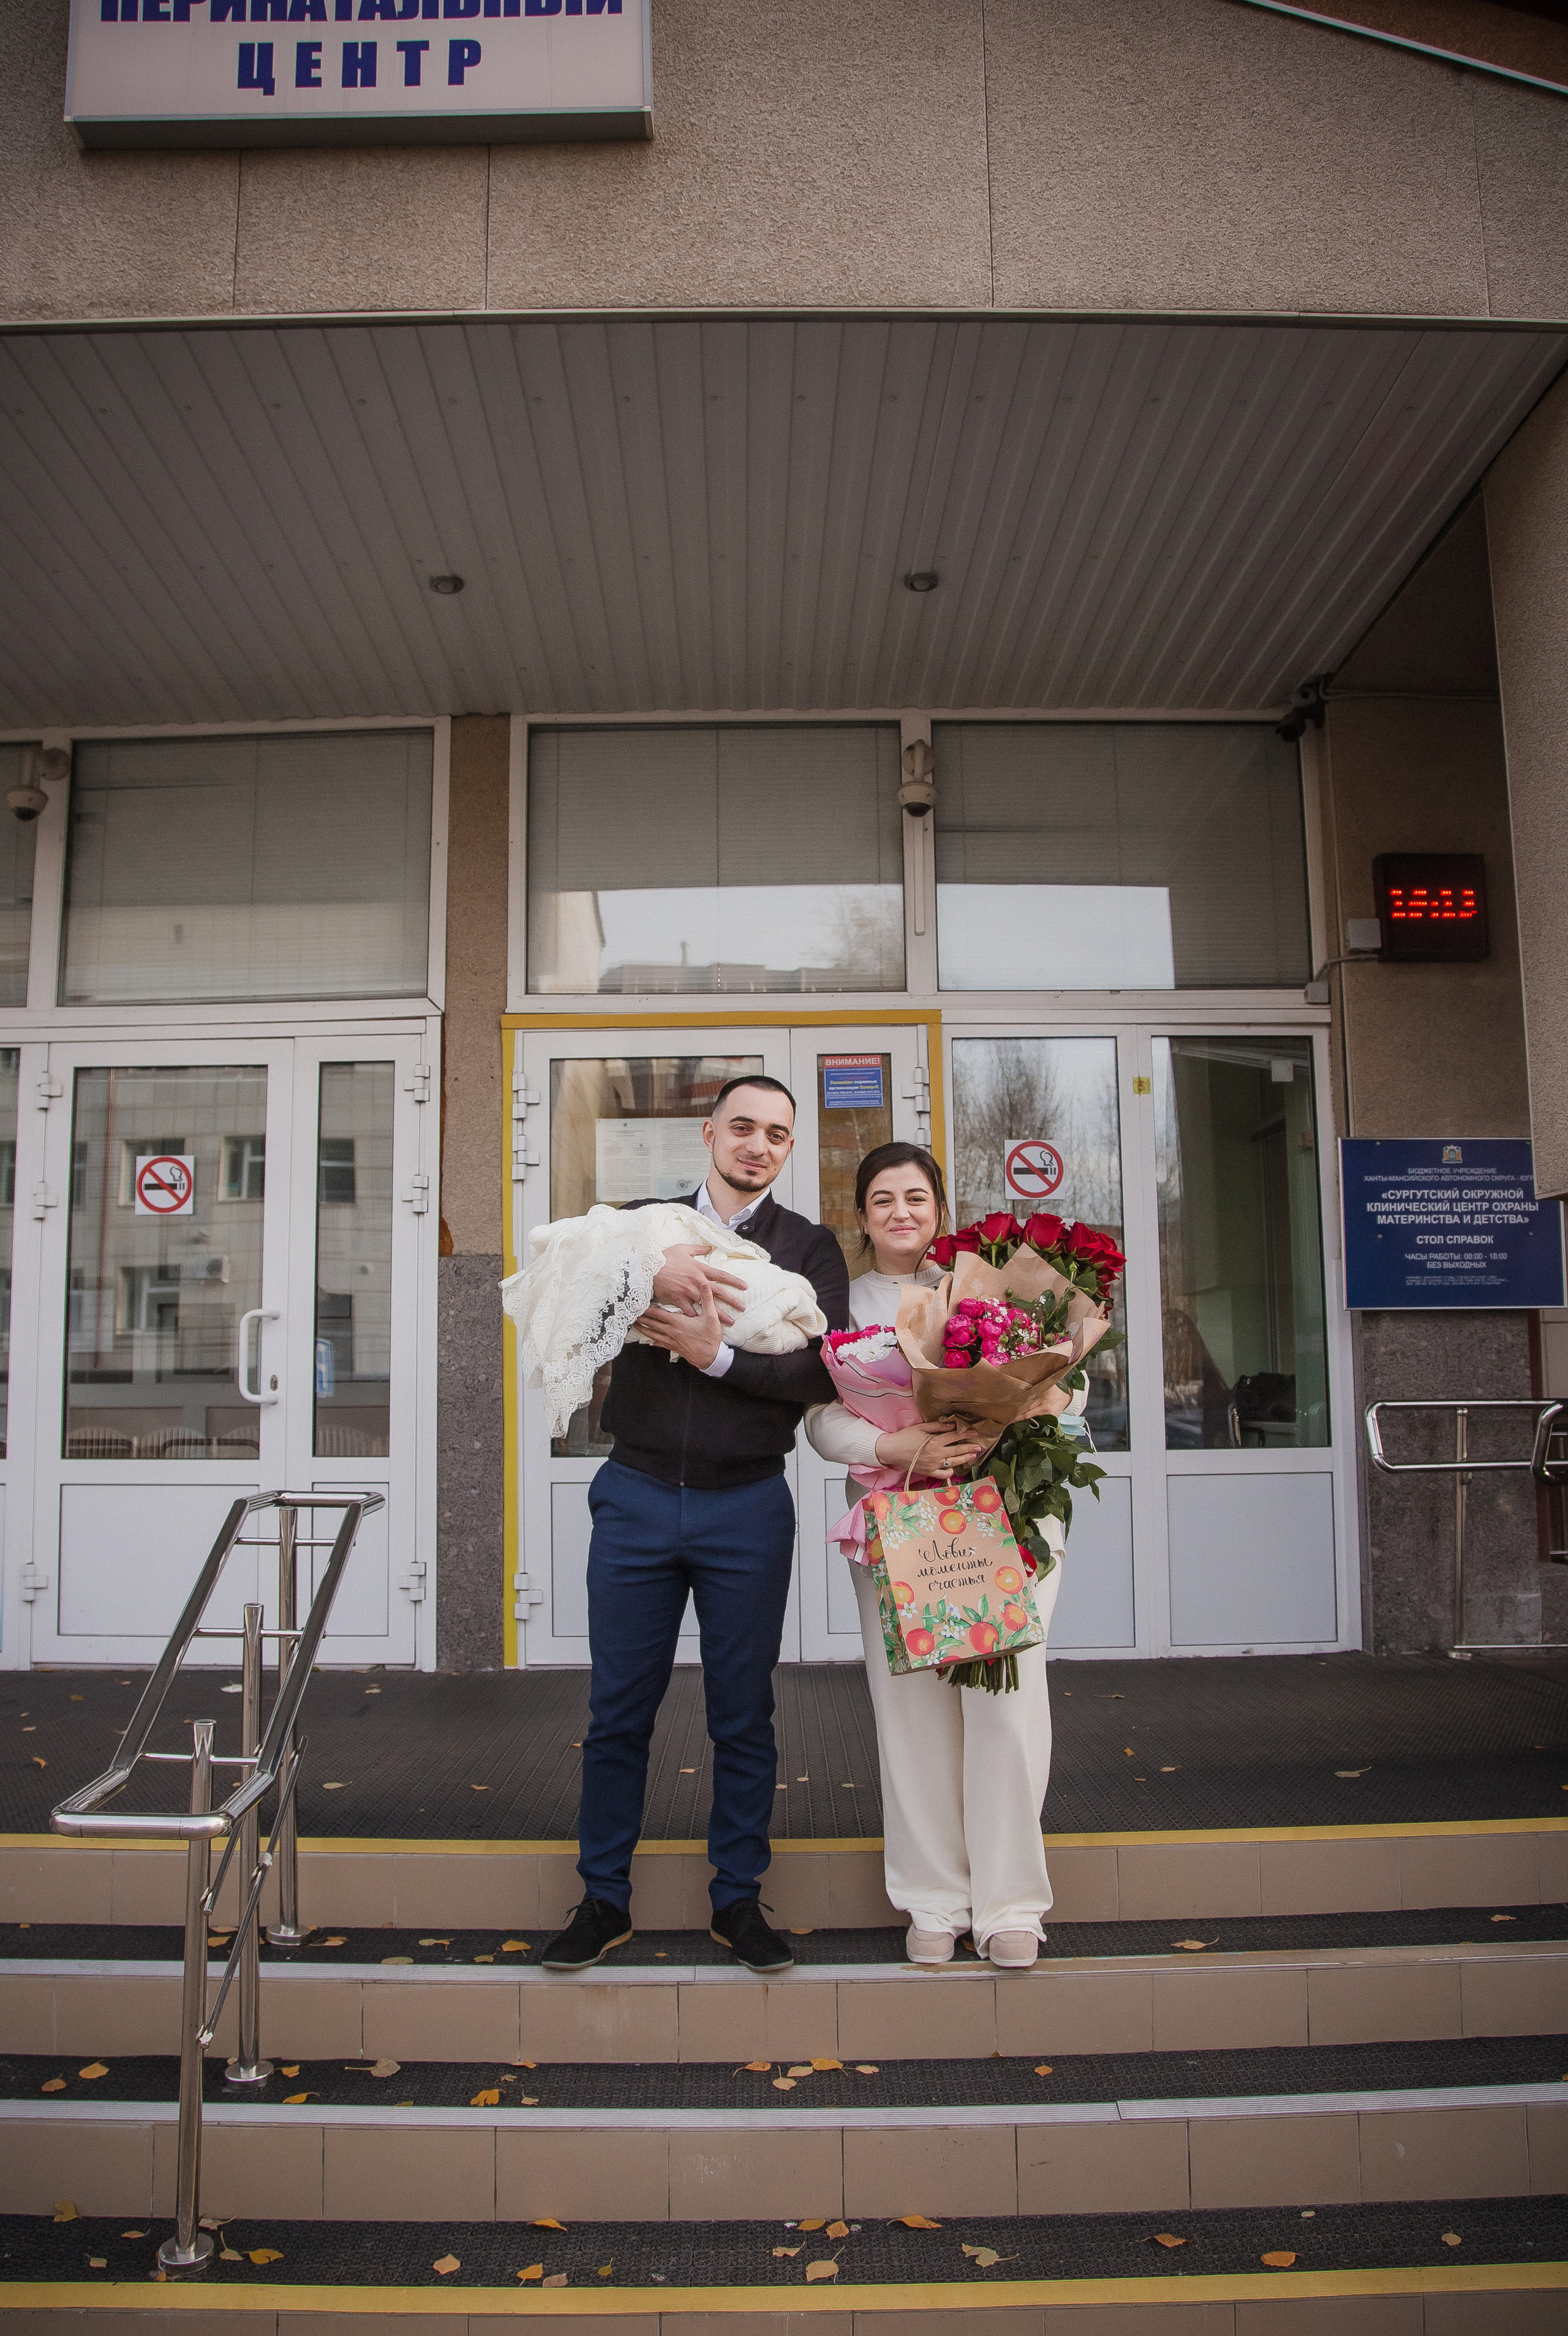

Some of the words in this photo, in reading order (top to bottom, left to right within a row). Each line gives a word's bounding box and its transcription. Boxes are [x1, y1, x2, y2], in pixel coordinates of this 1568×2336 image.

[238, 39, 482, 96] ЦЕНТР
[825, 1057, 880, 1066] ВНИМАНИЕ!
[1382, 1188, 1460, 1199] «СУРГУТСКИЙ
[1463, 1188, 1523, 1199] ОКРУЖНОЙ
[1366, 1200, 1450, 1212] КЛИНИЧЕСКИЙ
[1453, 1202, 1489, 1213] ЦЕНТР
[1492, 1202, 1539, 1211] ОХРАНЫ
[1377, 1215, 1460, 1224] МАТЕРИНСТВА
[1463, 1214, 1471, 1224] И
[1474, 1214, 1529, 1225] ДЕТСТВА»
[1416, 1235, 1444, 1244] СТОЛ
[1446, 1235, 1494, 1244] СПРАВОК
[918, 1537, 972, 1562] Лови
[917, 1558, 993, 1578] моменты
[928, 1574, 987, 1591] счастья
